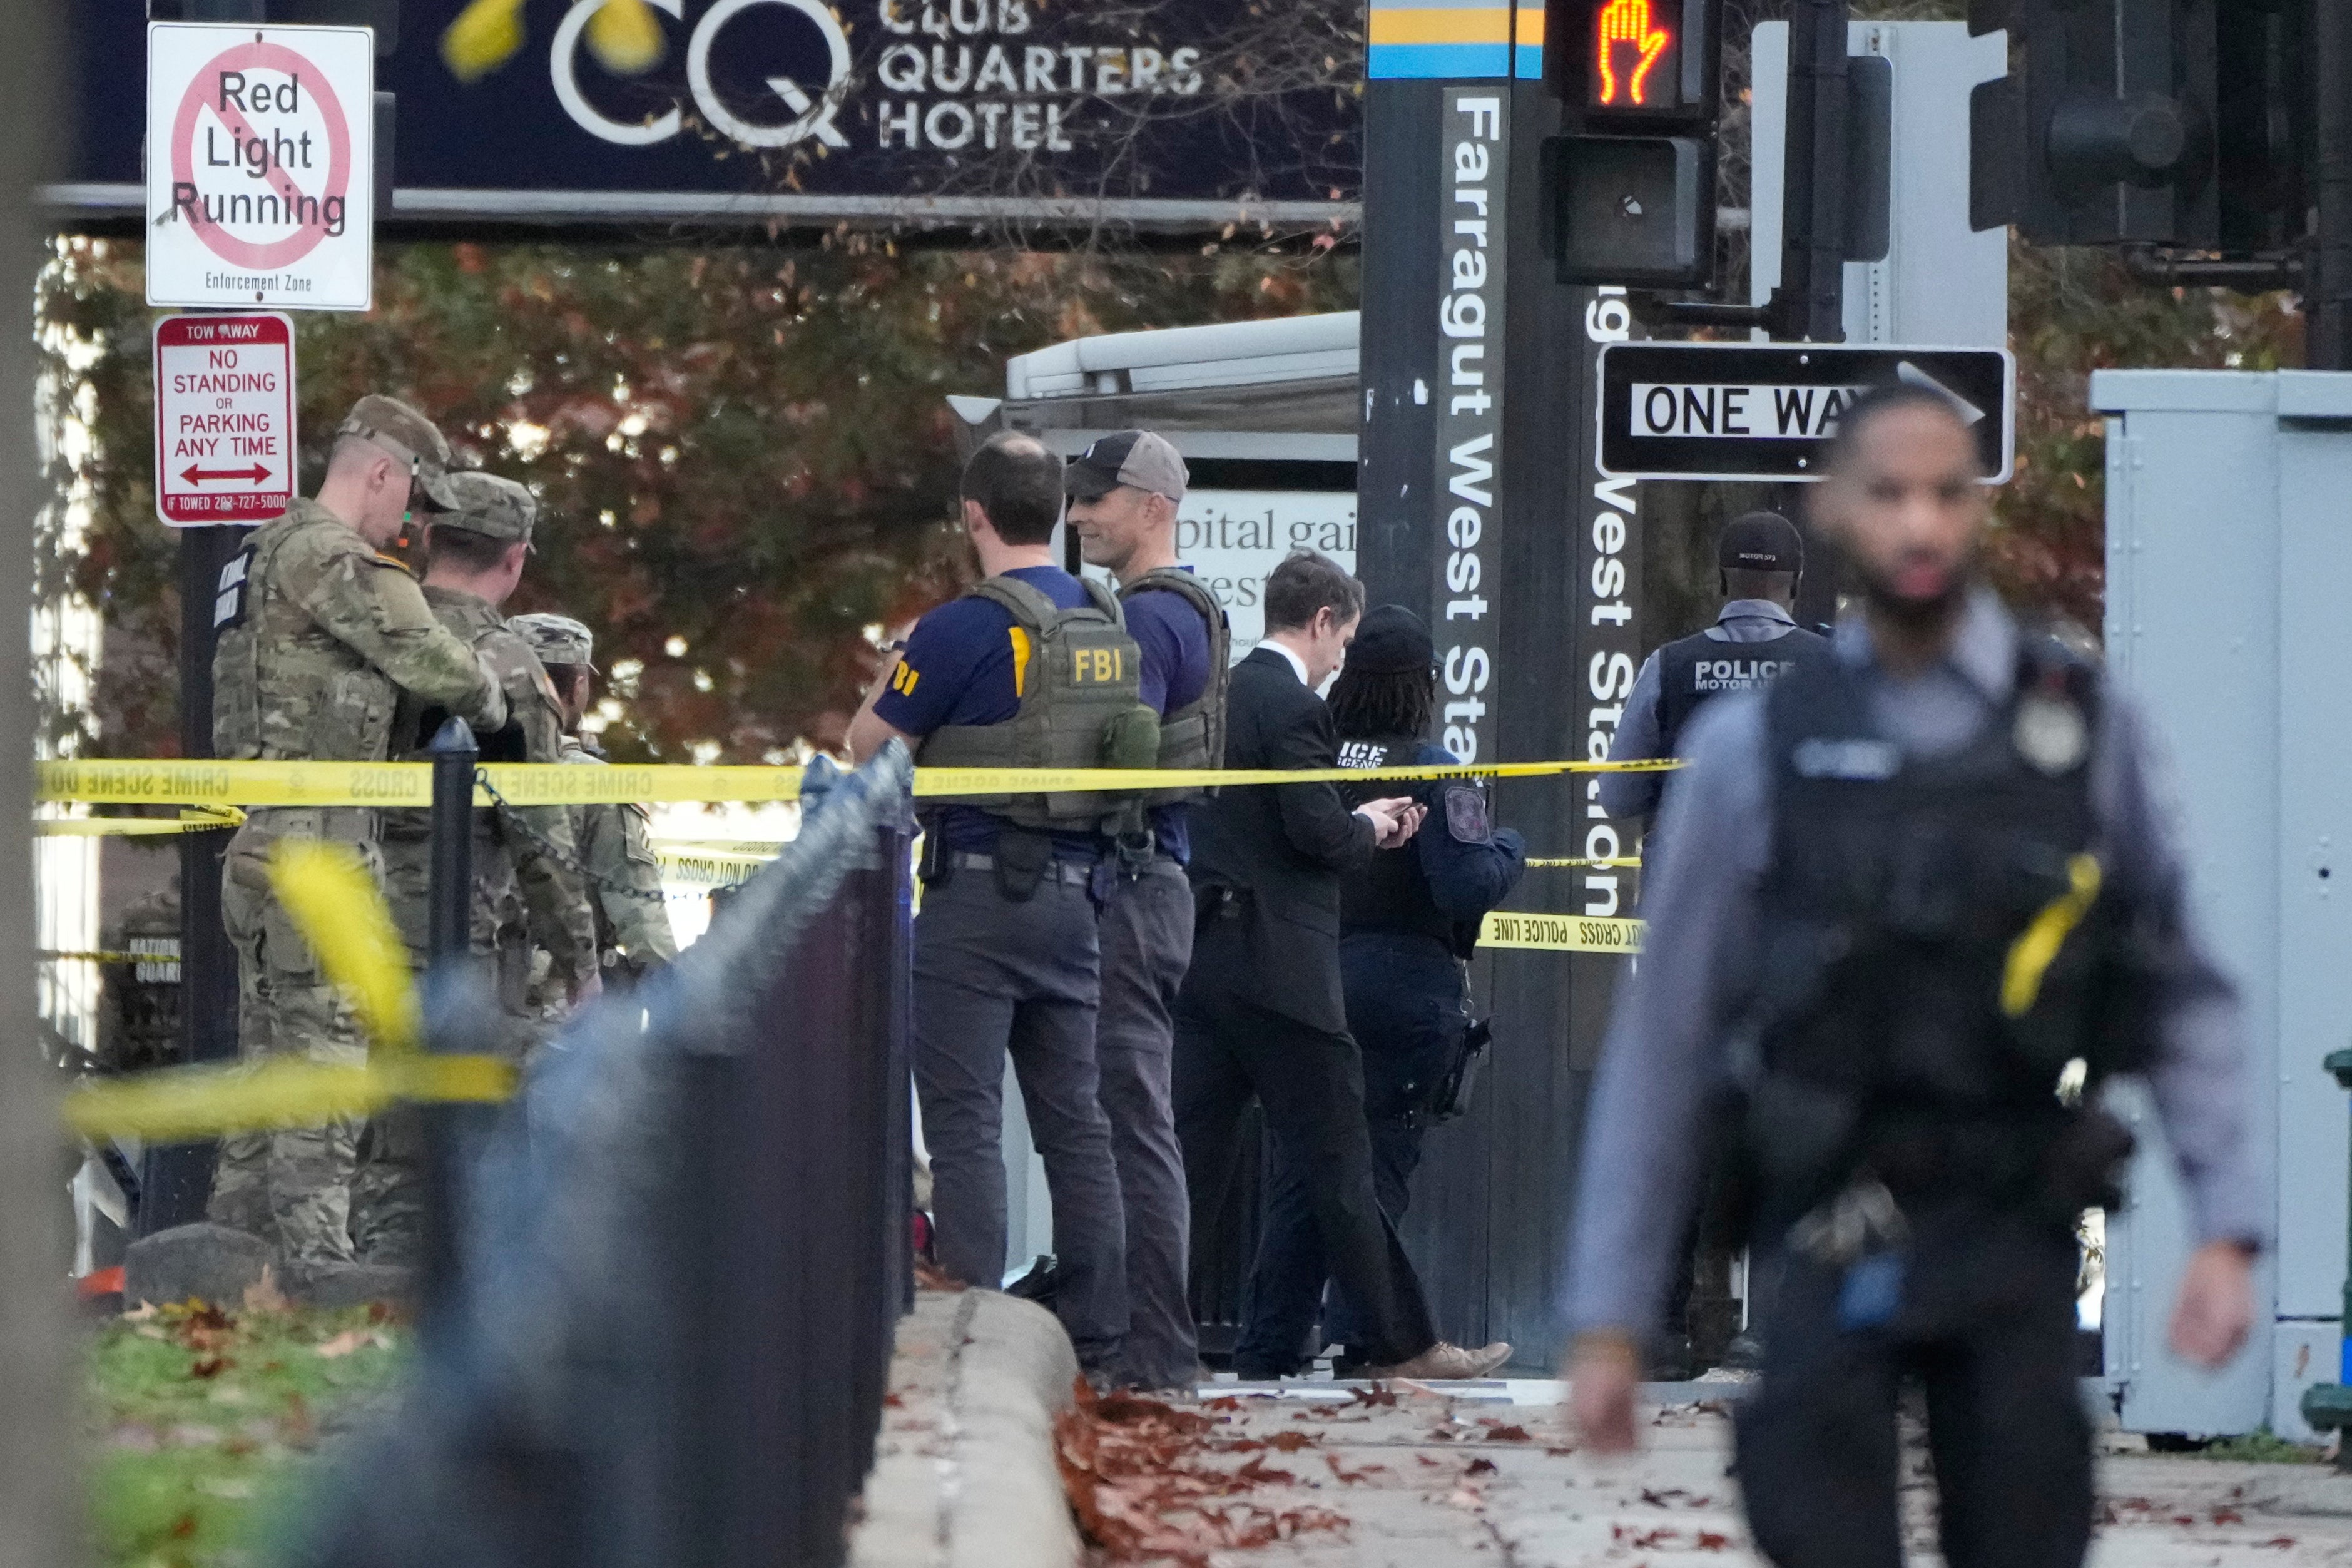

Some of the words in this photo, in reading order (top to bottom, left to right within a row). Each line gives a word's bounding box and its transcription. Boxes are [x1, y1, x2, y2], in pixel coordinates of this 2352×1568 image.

[878, 0, 1031, 35] CLUB
[878, 44, 1203, 95] QUARTERS
[219, 71, 298, 114] Red
[879, 101, 1072, 151] HOTEL
[207, 127, 312, 178] Light
[171, 181, 345, 237] Running
[1440, 98, 1502, 416] Farragut
[206, 272, 279, 292] Enforcement
[285, 274, 312, 292] Zone
[186, 325, 215, 339] TOW
[210, 349, 238, 369] NO
[174, 373, 276, 394] STANDING
[216, 397, 233, 409] OR
[1644, 386, 1750, 435] ONE
[180, 413, 270, 434] PARKING
[175, 438, 218, 457] ANY
[230, 437, 277, 456] TIME
[167, 496, 177, 511] IF
[180, 496, 210, 511] TOWED
[1445, 433, 1494, 621] West
[1074, 648, 1122, 683] FBI
[1695, 679, 1751, 690] MOTOR
[1443, 645, 1490, 787] Sta
[676, 857, 715, 883] CROSS
[1493, 918, 1520, 942] LINE
[1524, 920, 1567, 944] POLICE
[1579, 921, 1621, 945] CROSS
